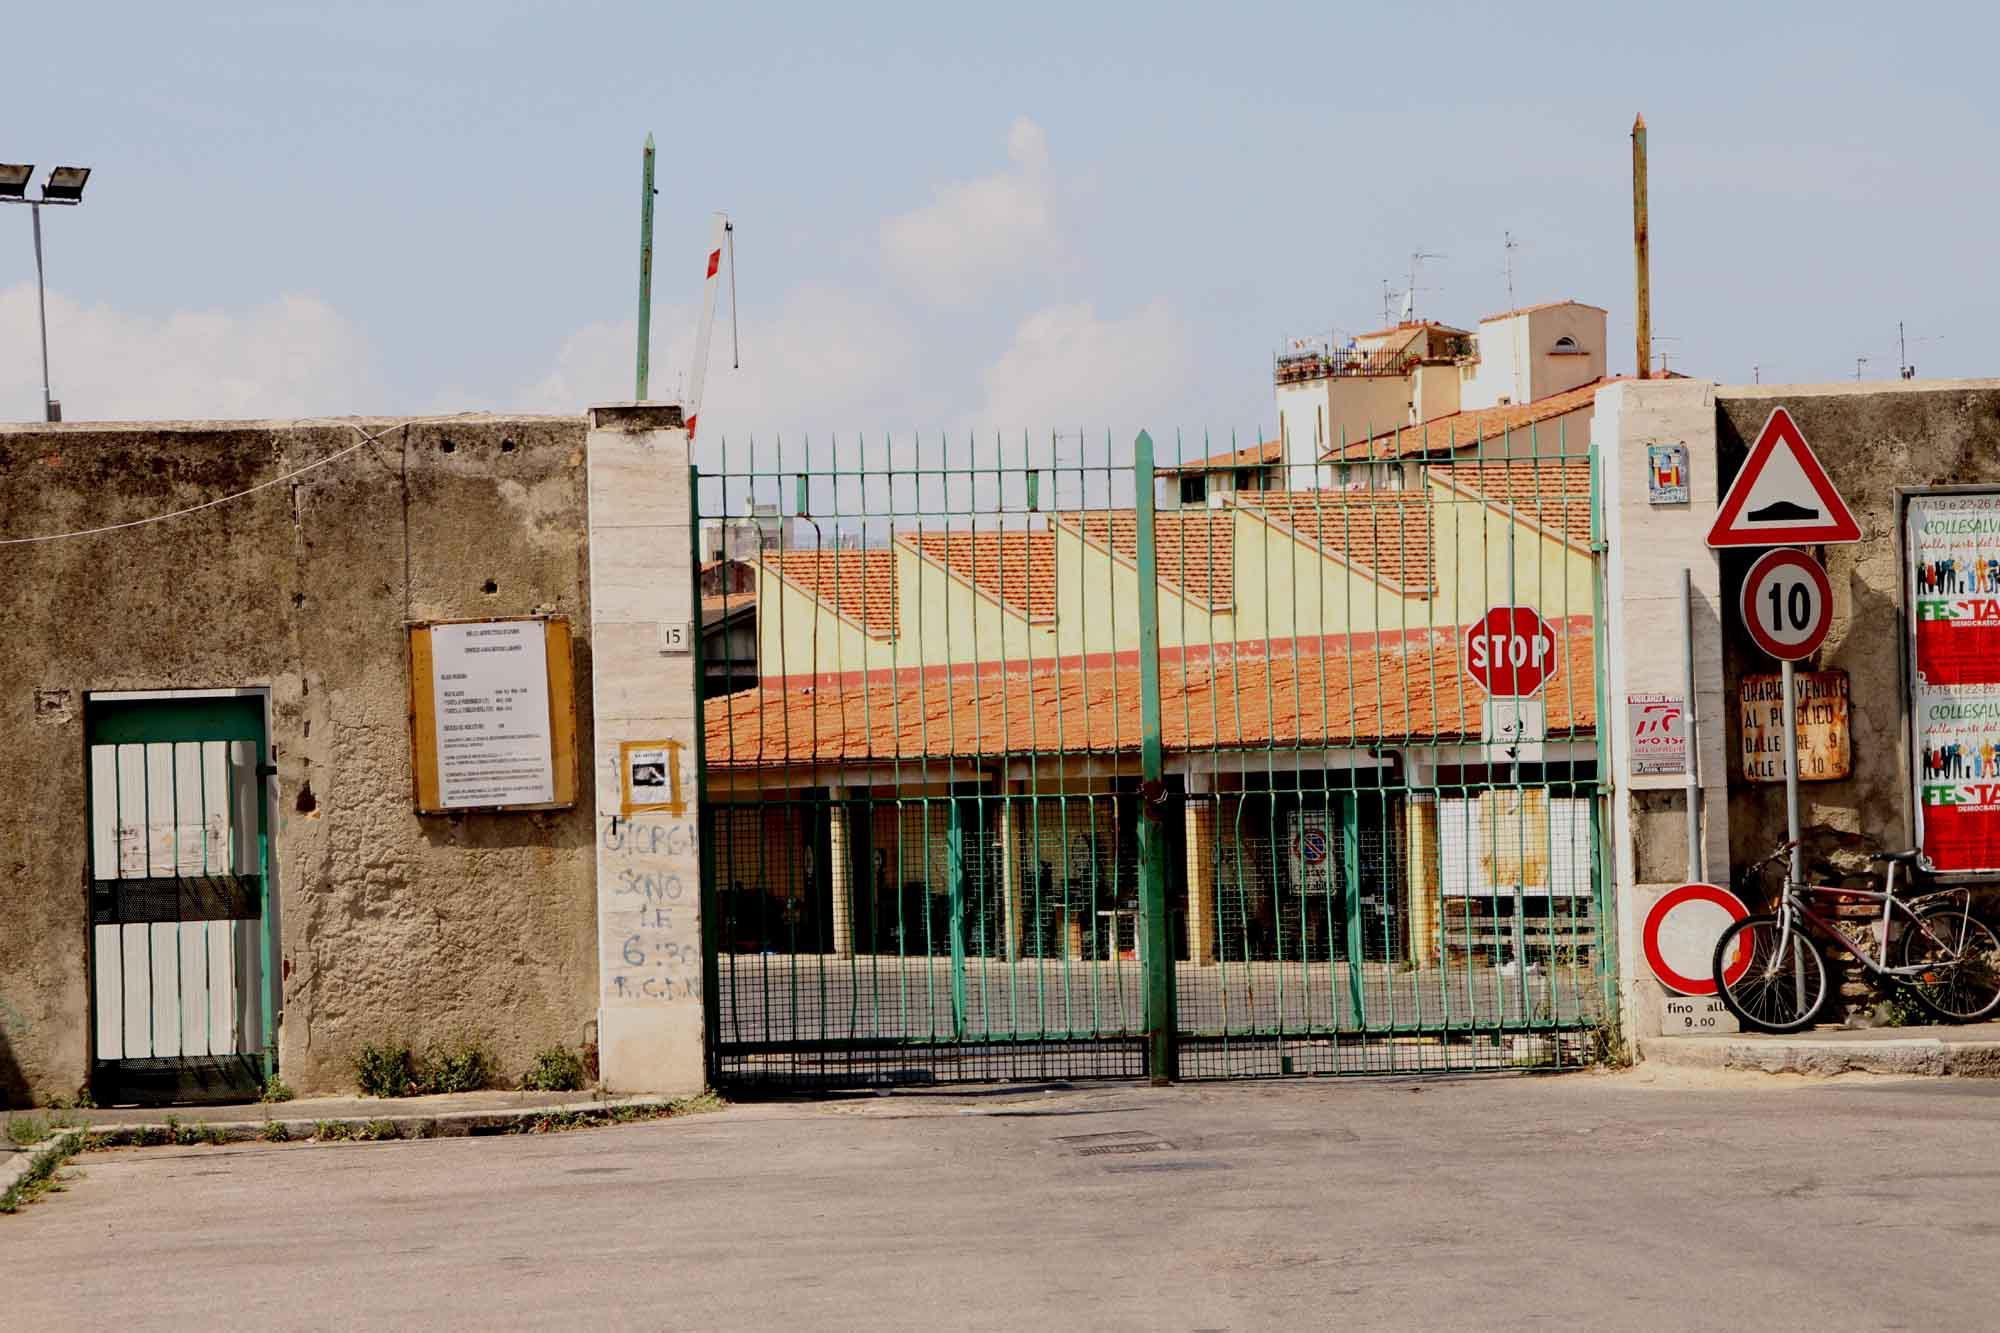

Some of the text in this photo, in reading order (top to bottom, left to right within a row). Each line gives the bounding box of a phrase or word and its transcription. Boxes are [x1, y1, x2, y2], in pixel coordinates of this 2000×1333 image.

[1924, 518, 2000, 535] COLLESALV
[1768, 583, 1811, 631] 10
[1918, 599, 2000, 621] FESTA
[666, 629, 681, 645] 15
[1472, 634, 1551, 668] STOP
[1797, 679, 1848, 700] VENDITE
[1744, 708, 1760, 728] AL
[1745, 735, 1781, 753] DALLE
[1829, 732, 1838, 749] 9
[1747, 760, 1775, 777] ALLE
[1923, 783, 2000, 806] FESTA
[1667, 1002, 1693, 1014] fino
[1684, 1017, 1716, 1028] 9.00
